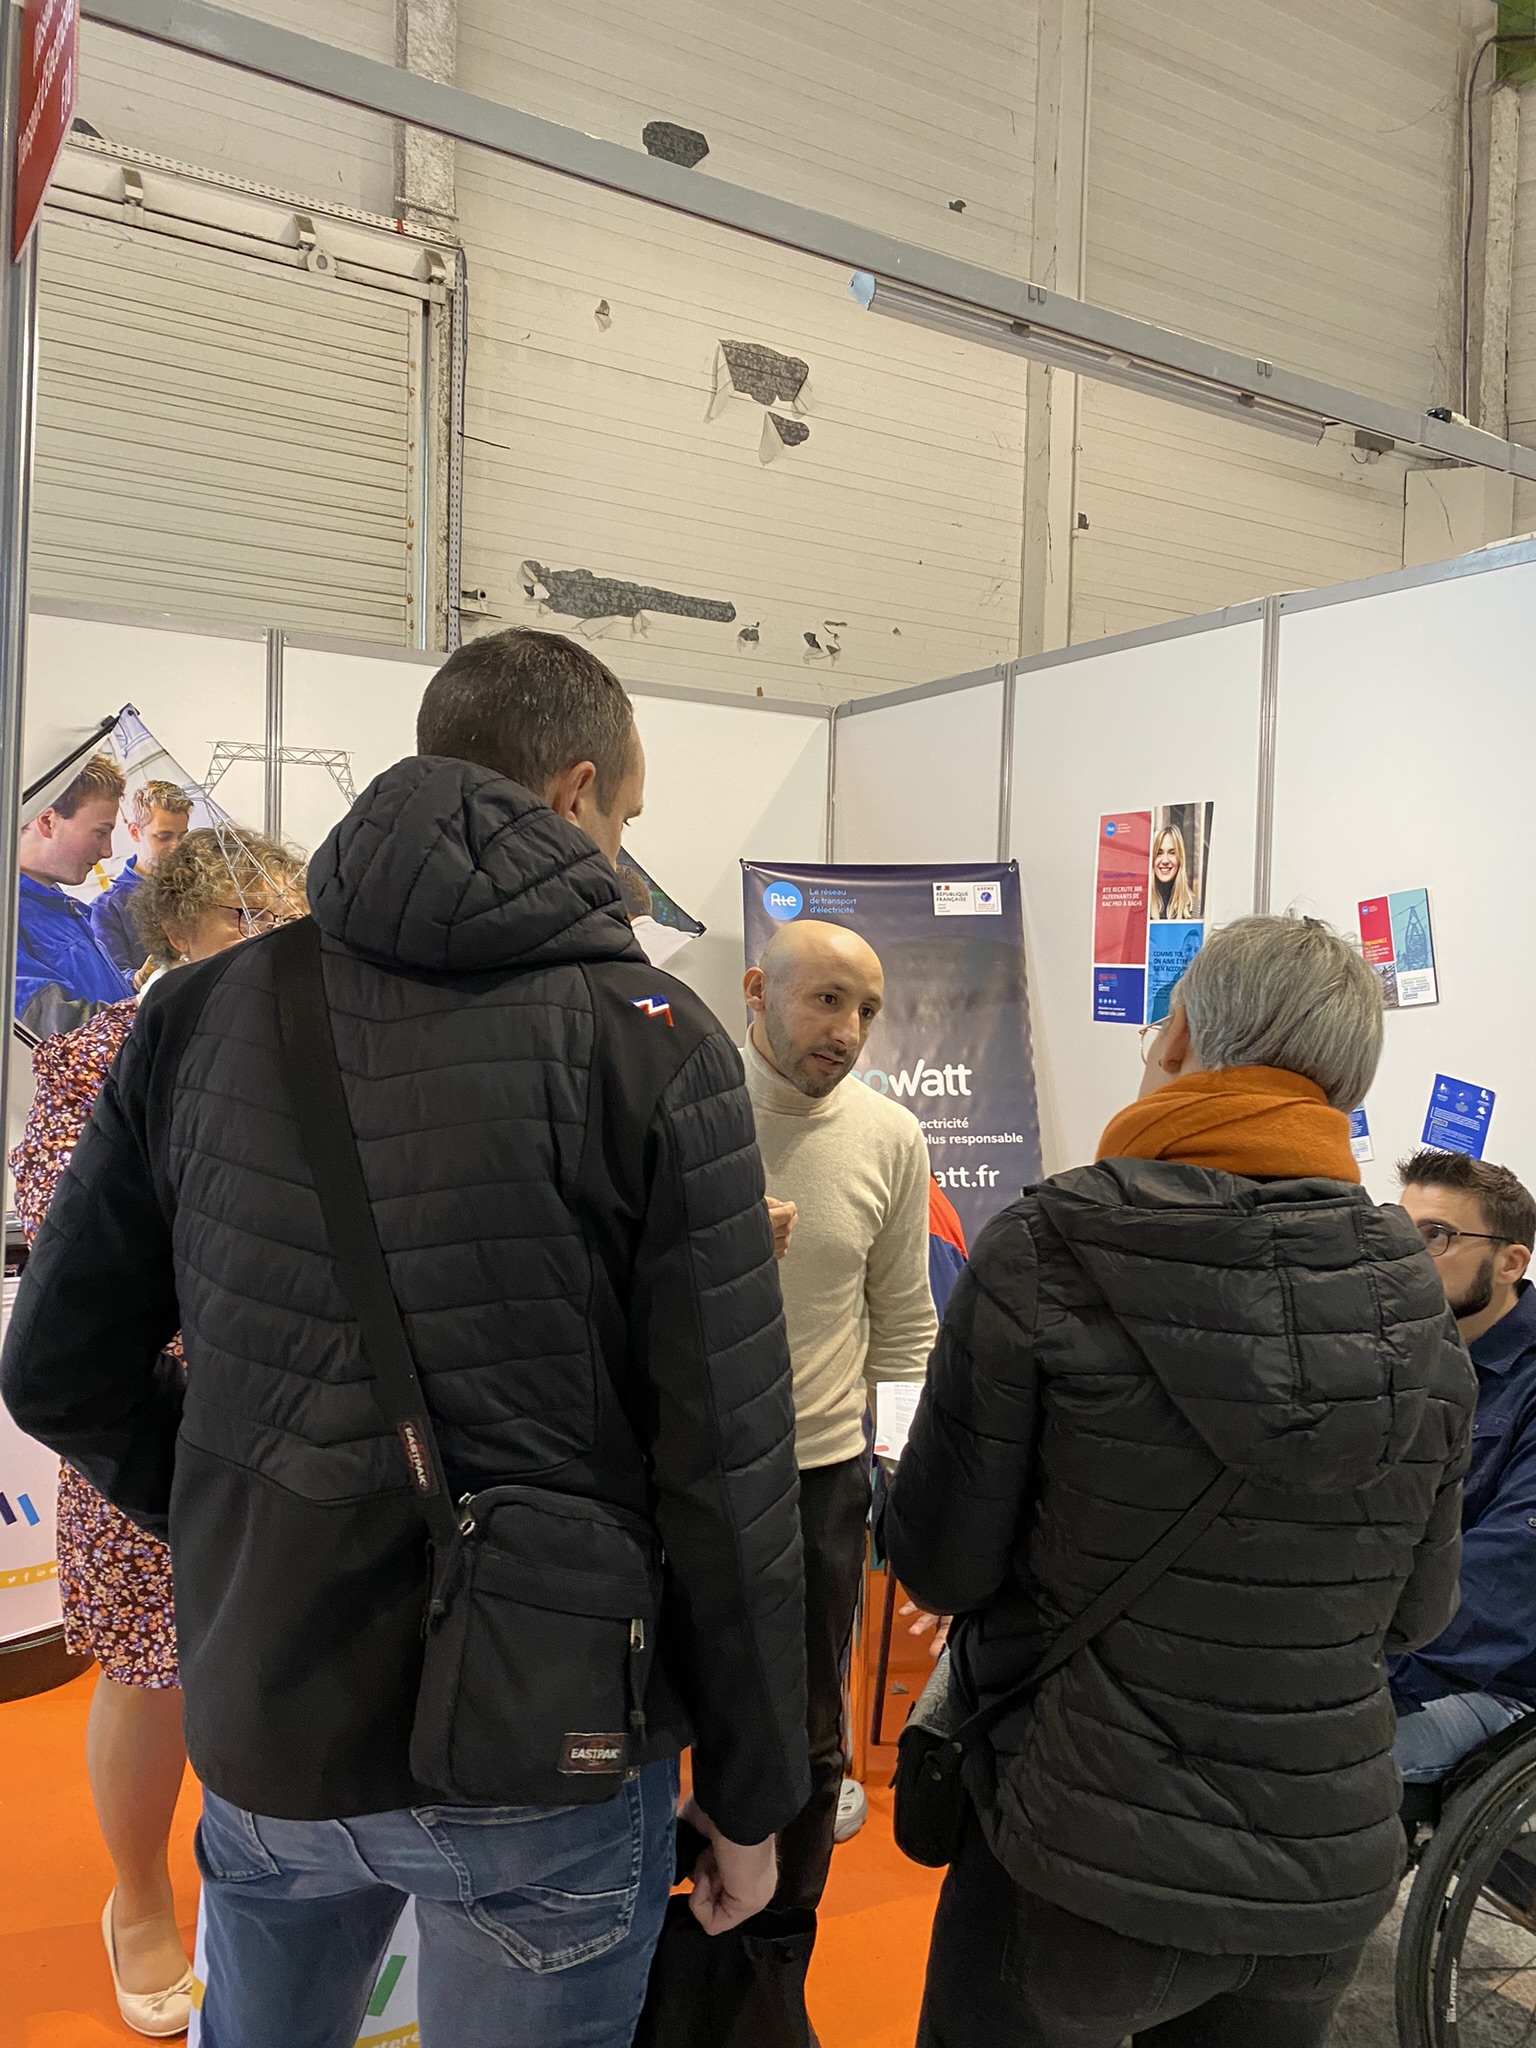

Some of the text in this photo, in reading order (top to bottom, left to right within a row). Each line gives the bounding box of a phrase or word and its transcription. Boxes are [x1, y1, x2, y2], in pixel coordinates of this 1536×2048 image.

[771, 893, 797, 906] Rte
[821, 898, 857, 906] transport
[920, 1117, 969, 1129] ectricité
[949, 1133, 1024, 1146] responsable
[933, 1164, 1000, 1188] att.fr
[404, 1427, 428, 1487] EASTPAK
[571, 1748, 619, 1759] EASTPAK
